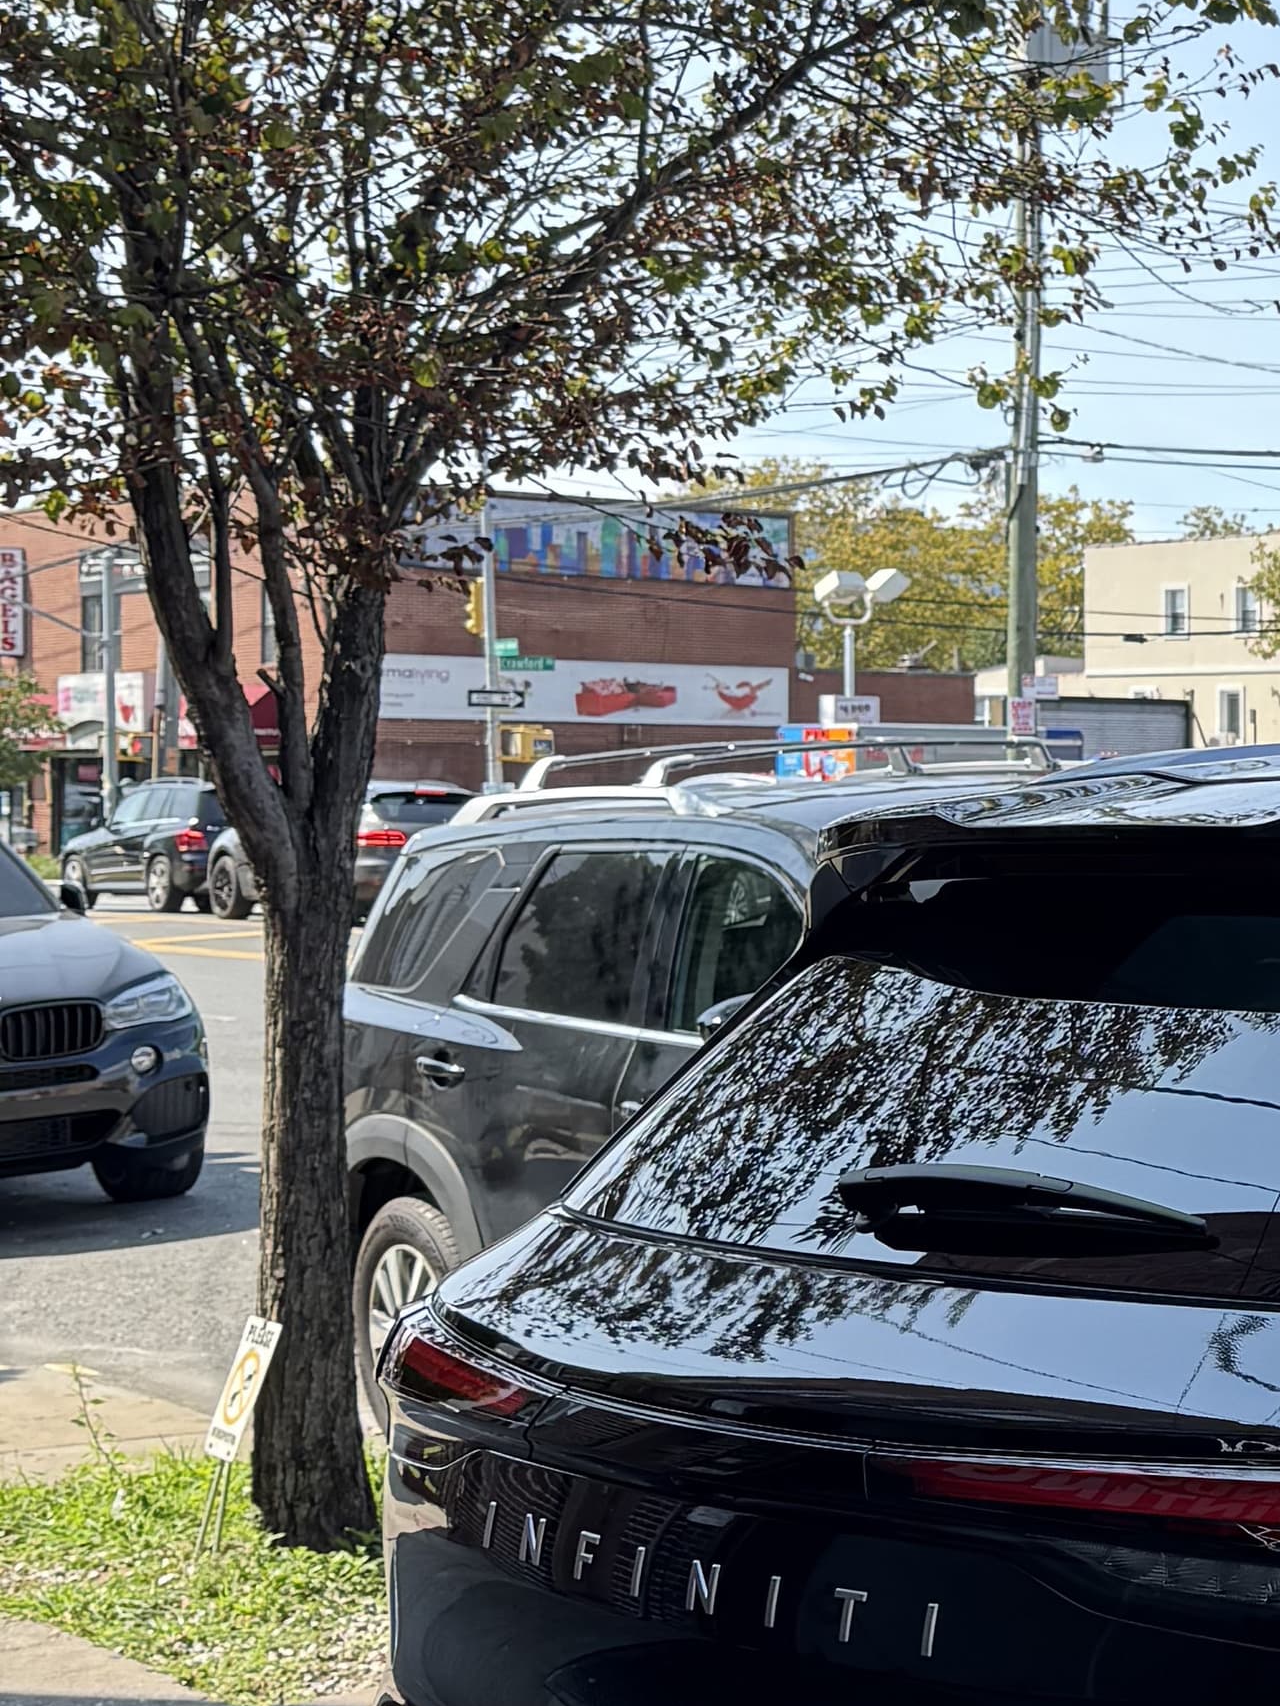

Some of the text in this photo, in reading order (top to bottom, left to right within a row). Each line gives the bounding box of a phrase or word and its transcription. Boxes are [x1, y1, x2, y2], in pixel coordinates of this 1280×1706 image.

[0, 552, 18, 652] BAGELS
[501, 656, 544, 670] Crawford
[481, 1500, 939, 1658] INFINITI
